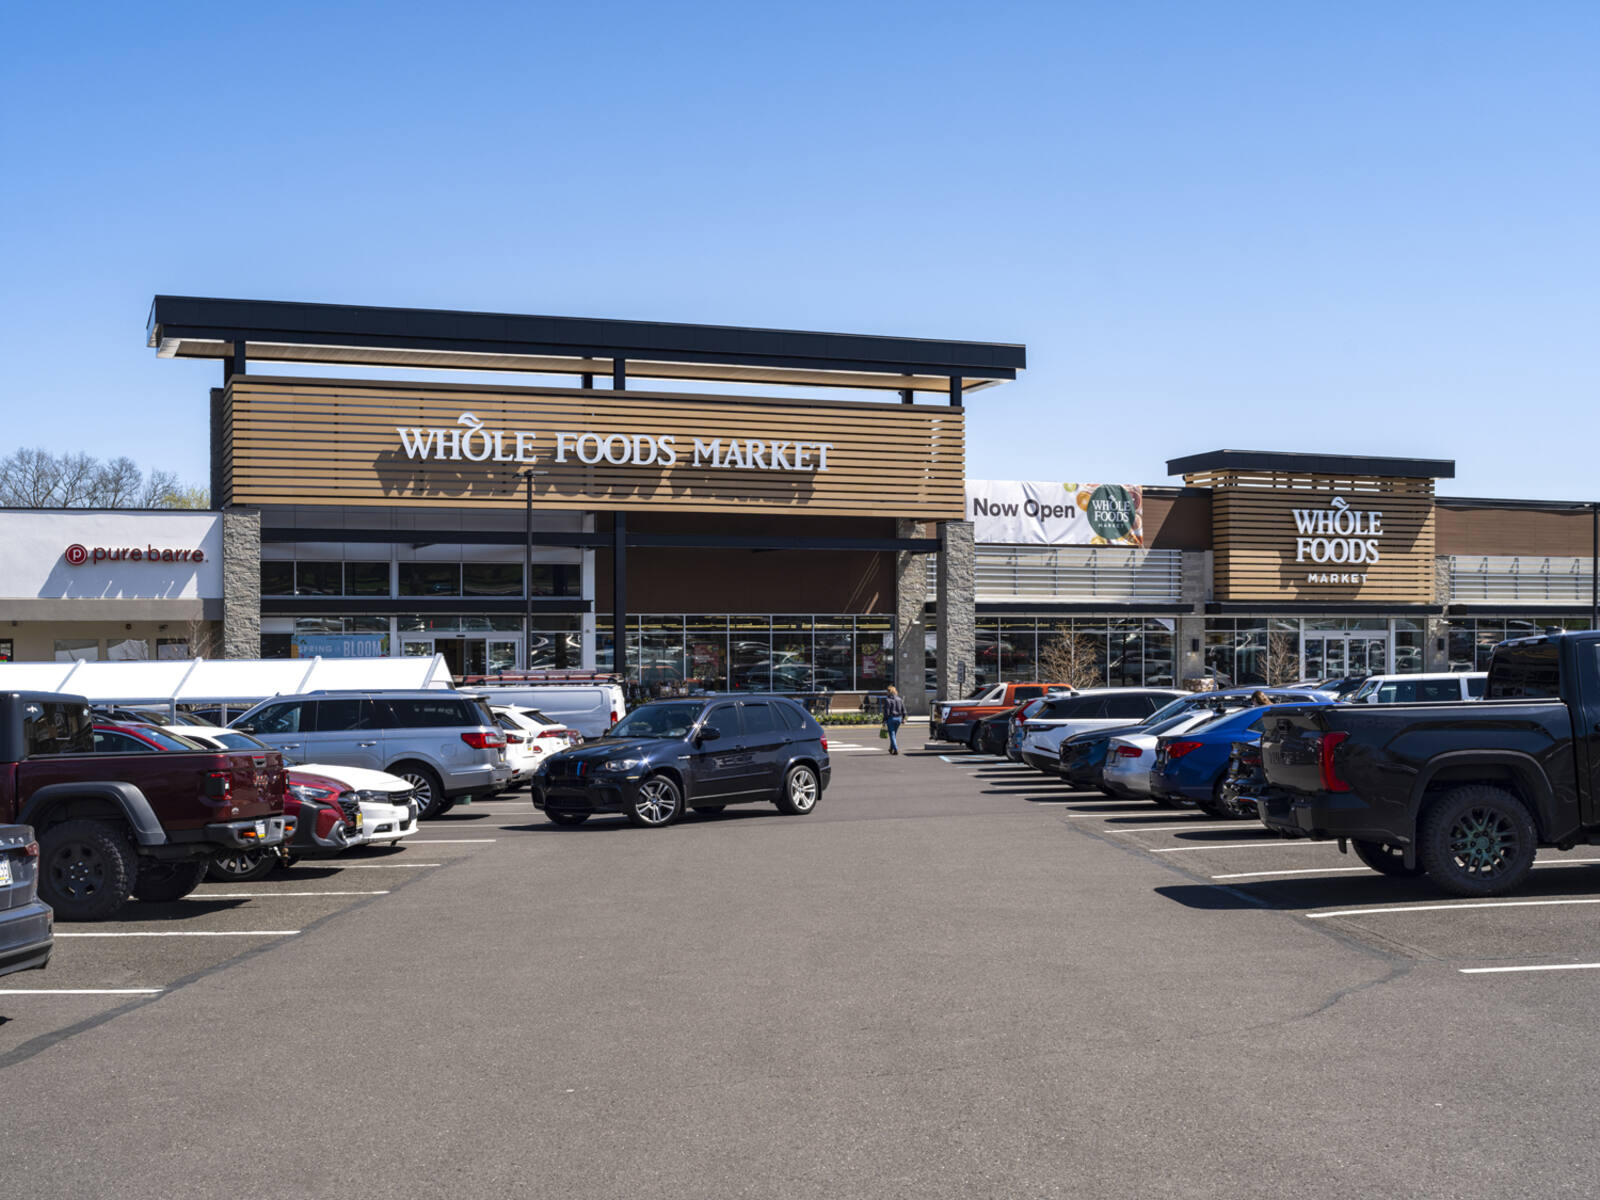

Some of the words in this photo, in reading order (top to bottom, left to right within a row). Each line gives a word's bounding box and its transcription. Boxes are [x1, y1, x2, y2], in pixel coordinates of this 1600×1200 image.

[396, 411, 537, 463] WHOLE
[554, 432, 678, 466] FOODS
[691, 437, 834, 472] MARKET
[973, 498, 1019, 517] Now
[1023, 499, 1076, 522] Open
[1092, 494, 1131, 512] WHOLE
[1094, 511, 1129, 523] FOODS
[1291, 496, 1384, 536] WHOLE
[93, 547, 143, 565] pure
[1295, 537, 1379, 564] FOODS
[1307, 573, 1369, 584] MARKET
[343, 640, 382, 657] BLOOM
